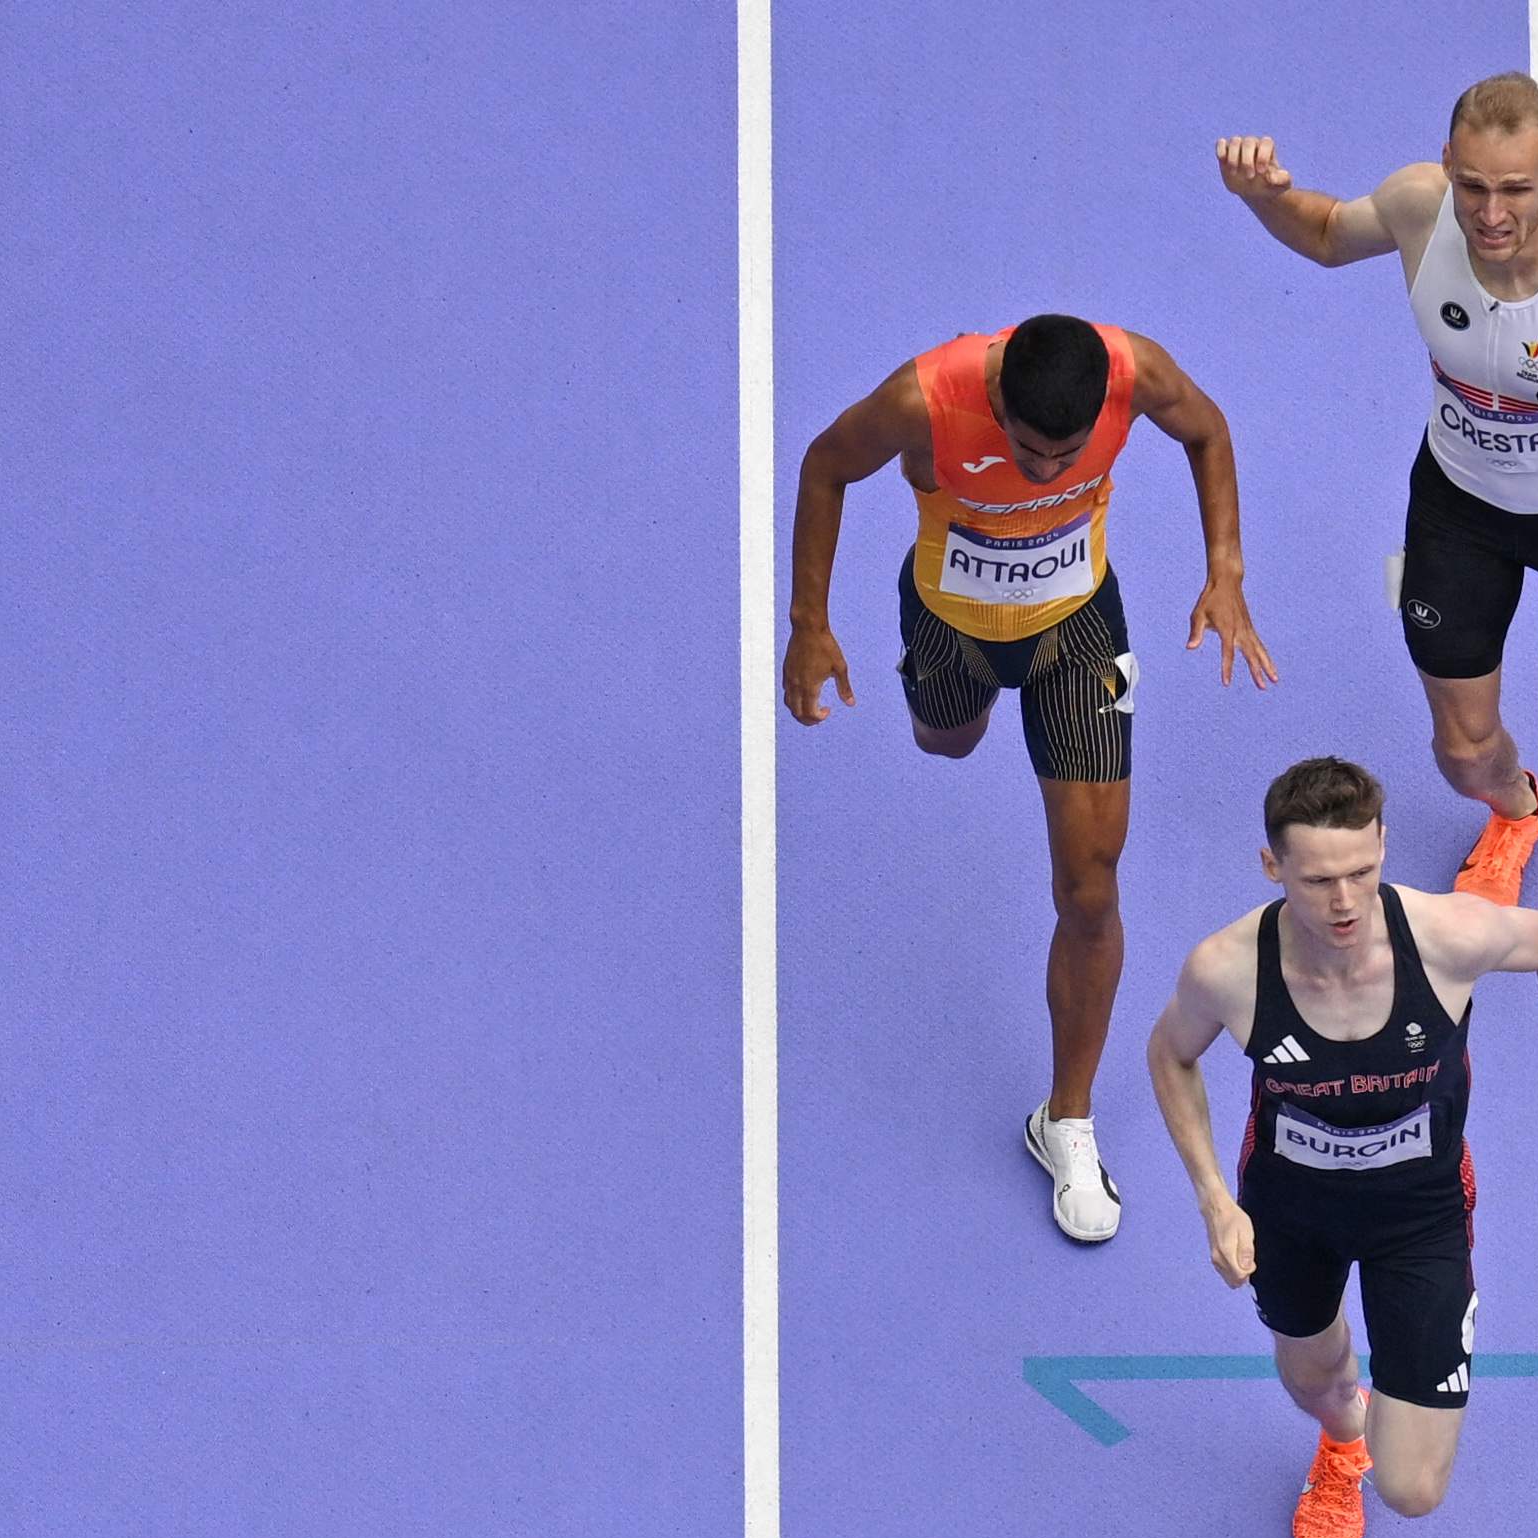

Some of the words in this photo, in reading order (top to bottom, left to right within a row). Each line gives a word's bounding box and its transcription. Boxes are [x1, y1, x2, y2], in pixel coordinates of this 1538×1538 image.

[984, 537, 1024, 548] PARIS
[1027, 532, 1060, 547] 2024
[949, 538, 1086, 584] ATTAOUI
[1265, 1077, 1345, 1097] GREAT
[1350, 1059, 1440, 1095] BRITAIN
[1285, 1121, 1422, 1159] BURGIN
